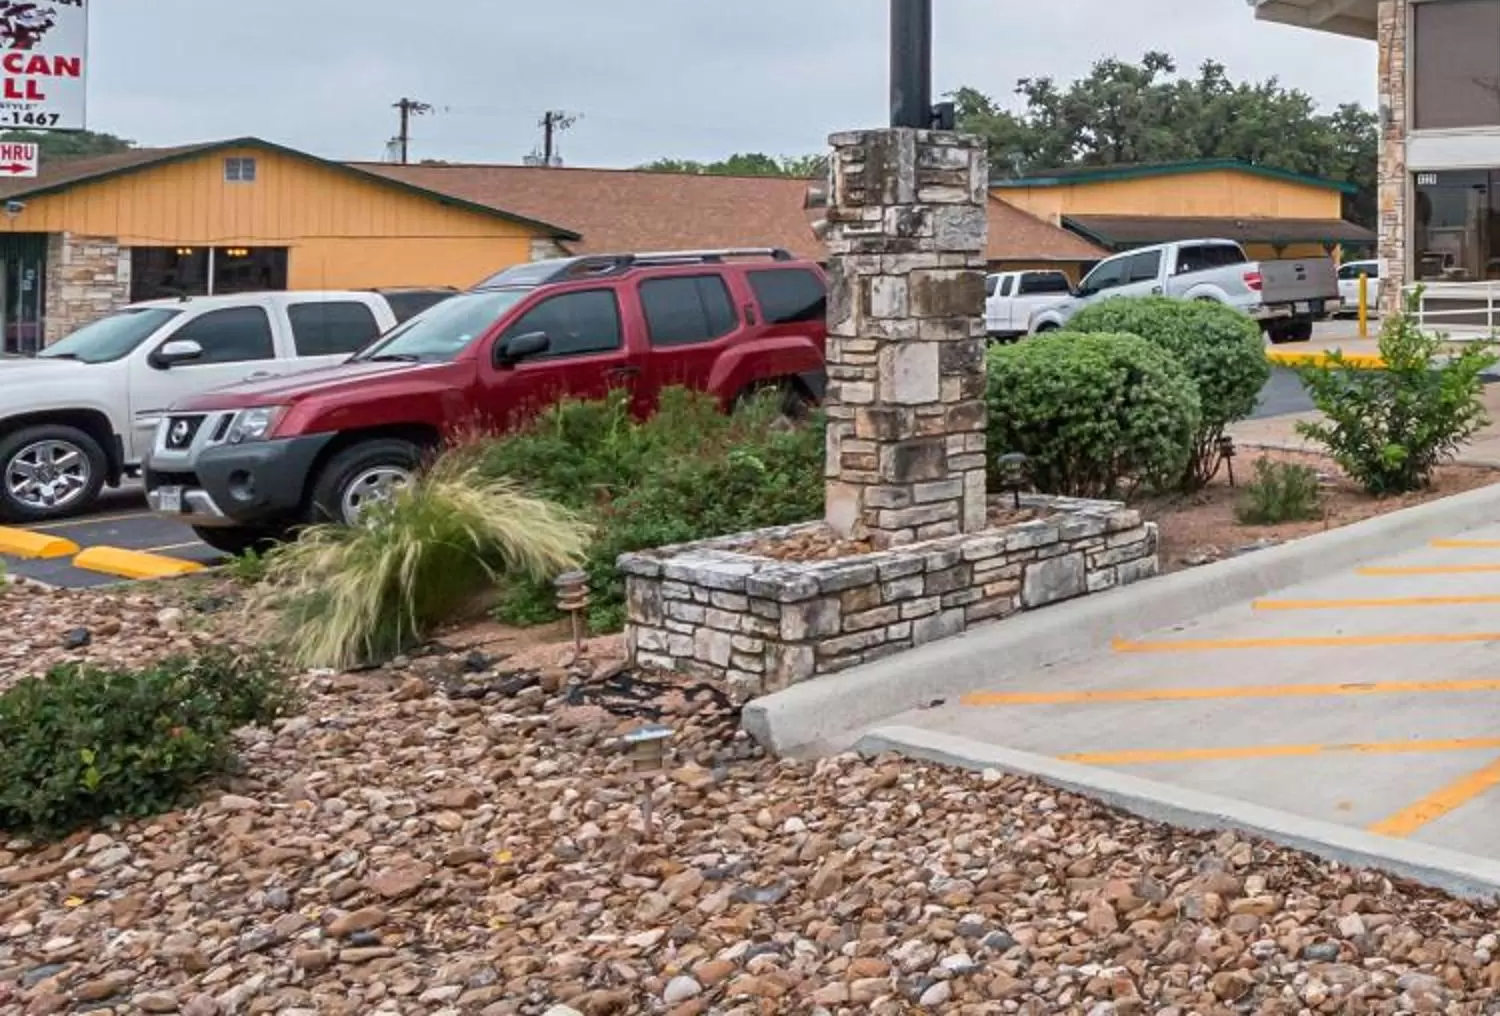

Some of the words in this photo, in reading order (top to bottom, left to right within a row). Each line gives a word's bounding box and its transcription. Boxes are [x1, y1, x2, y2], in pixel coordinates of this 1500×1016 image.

[3, 52, 81, 77] CAN
[4, 77, 45, 100] LL
[2, 111, 60, 126] -1467
[0, 144, 34, 161] HRU
